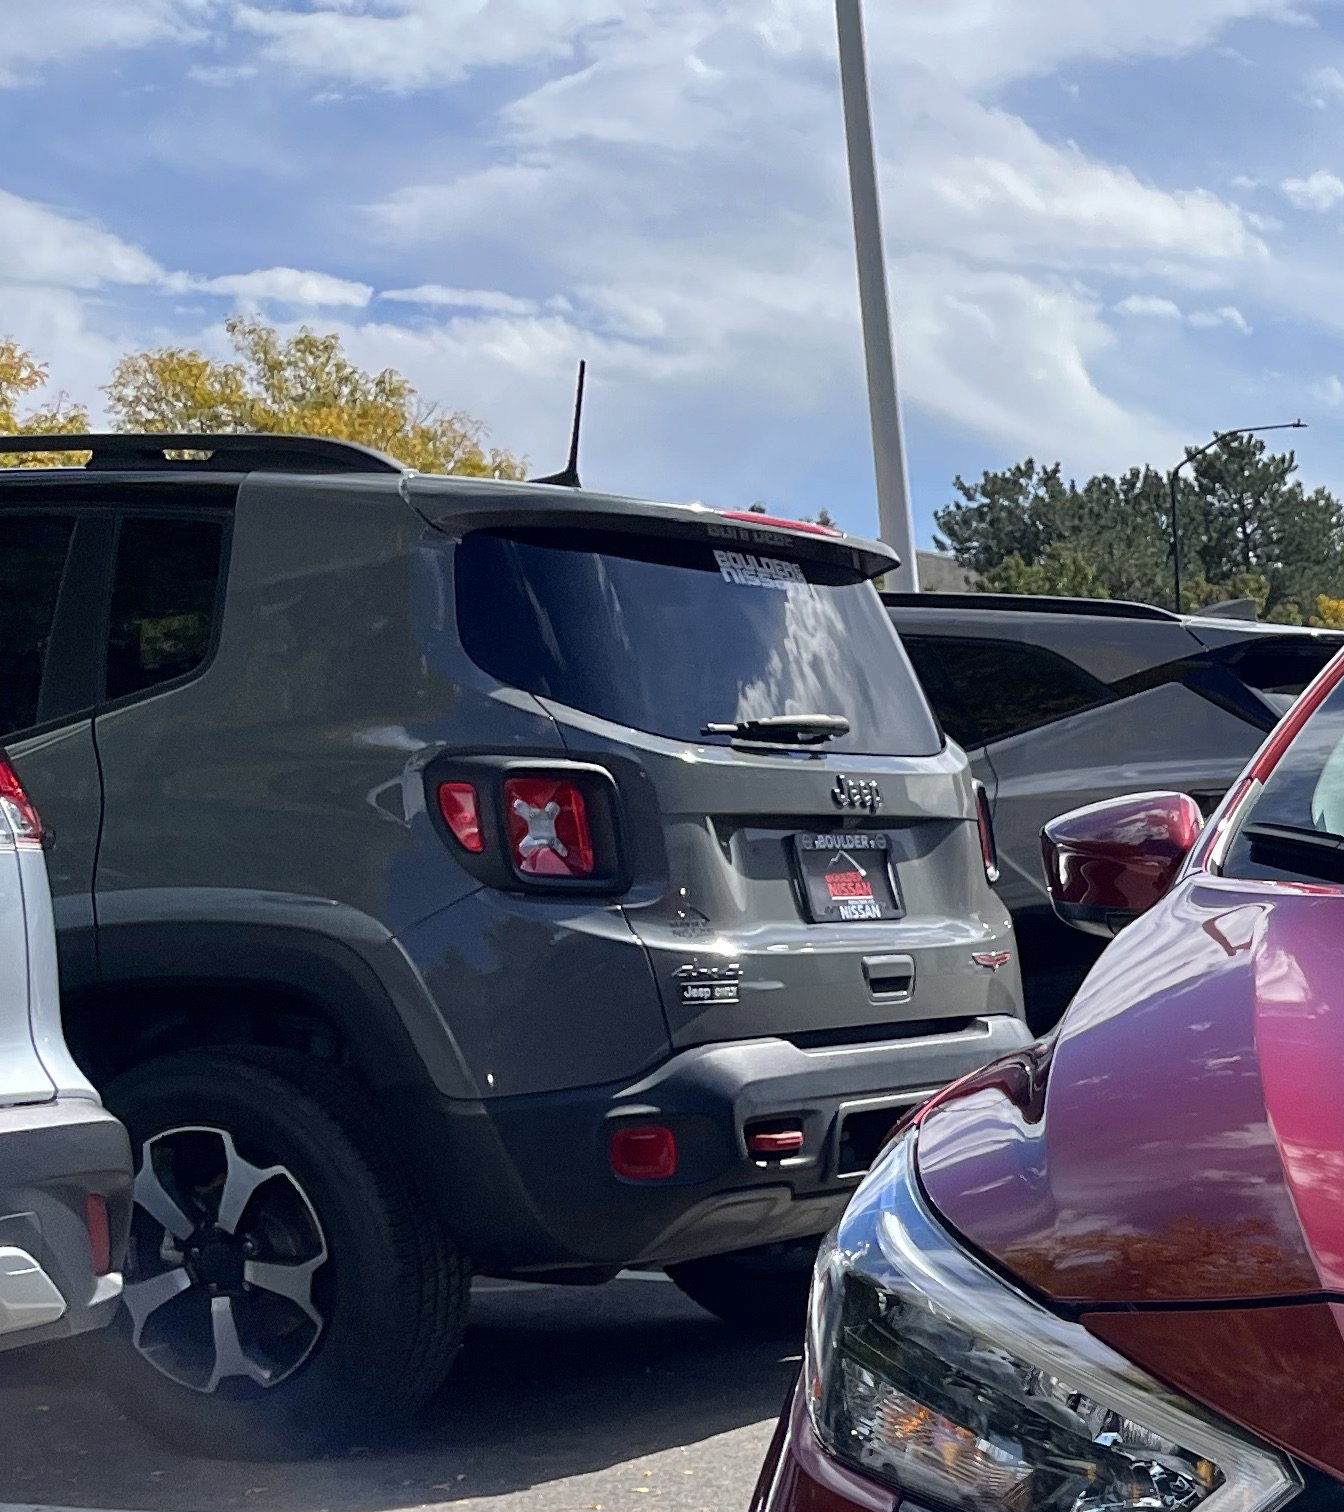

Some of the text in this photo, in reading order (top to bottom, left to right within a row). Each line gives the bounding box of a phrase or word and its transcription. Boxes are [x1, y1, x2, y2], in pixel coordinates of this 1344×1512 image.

[831, 775, 882, 814] Jeep
[817, 834, 868, 849] BOULDER
[827, 881, 873, 897] NISSAN
[839, 905, 881, 920] NISSAN
